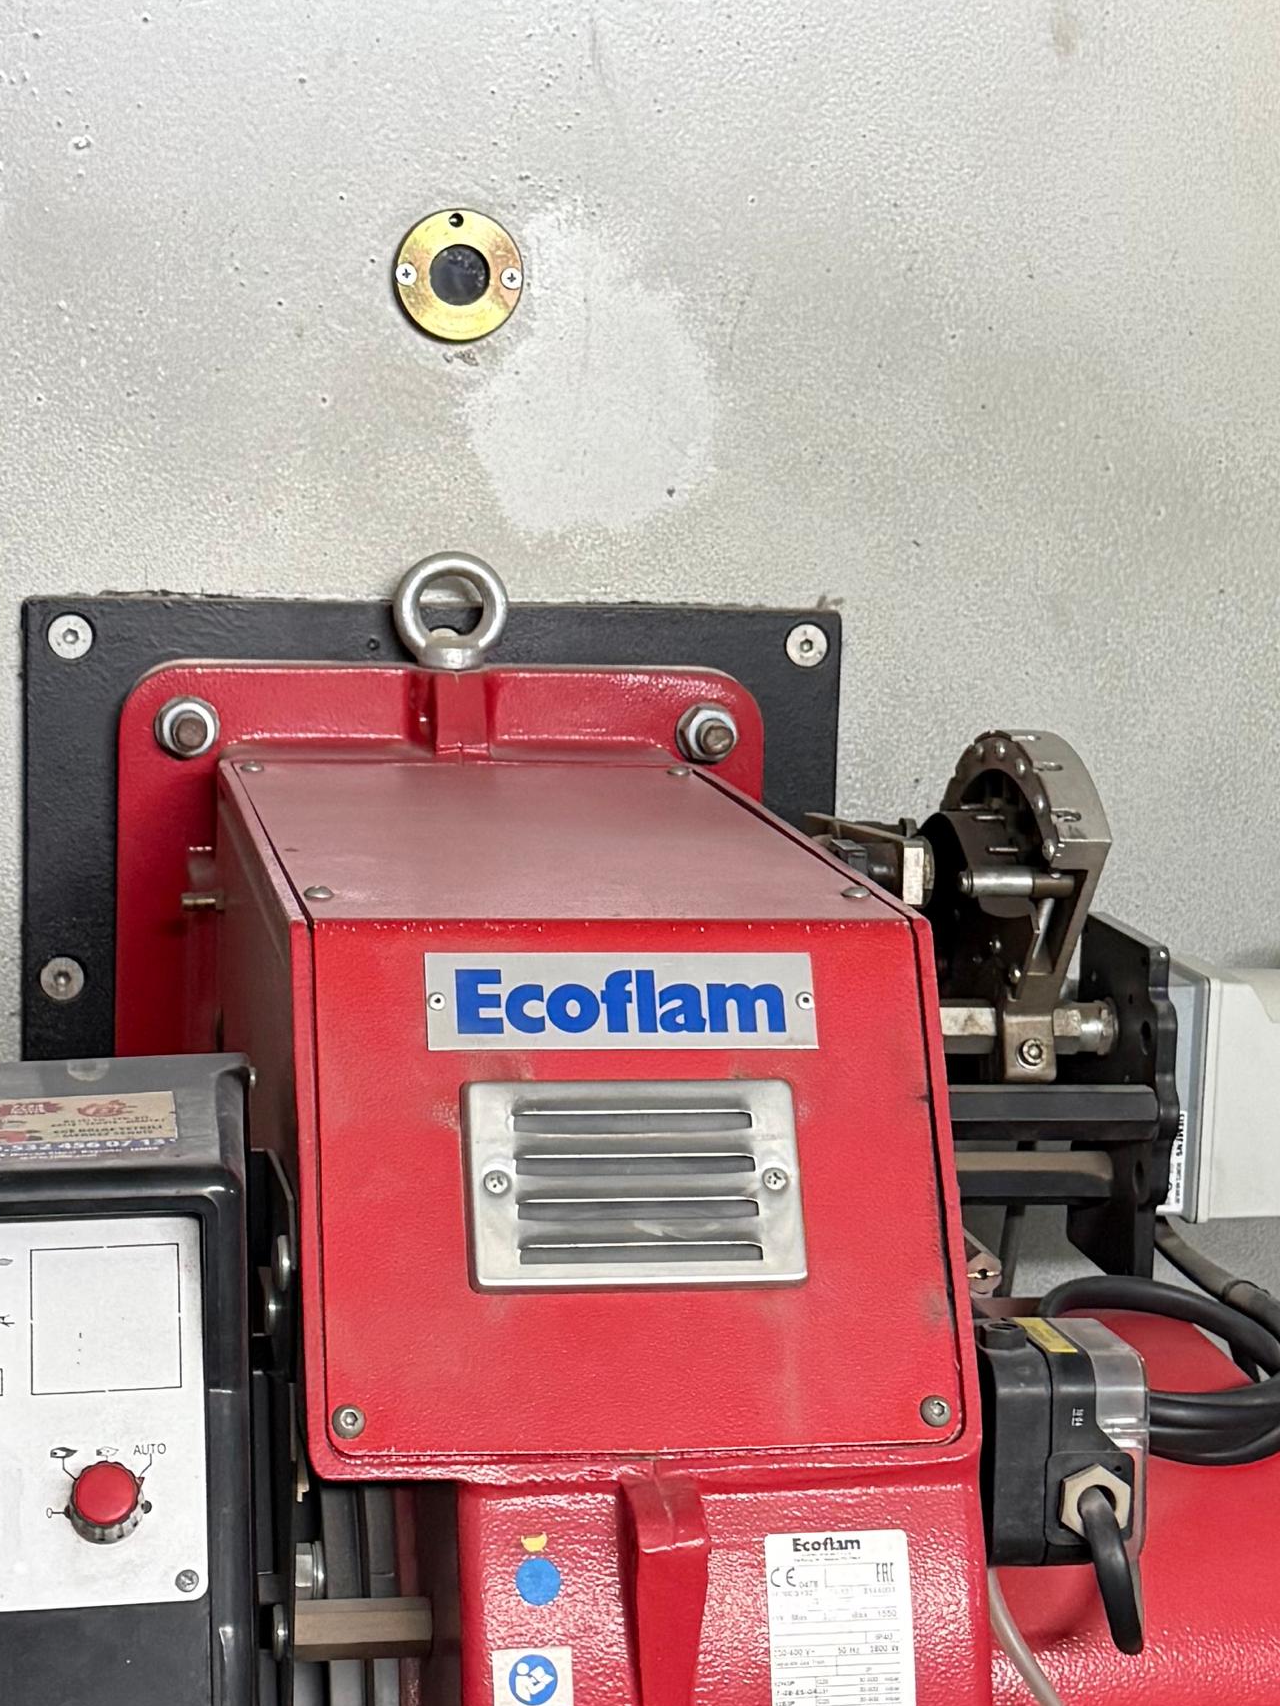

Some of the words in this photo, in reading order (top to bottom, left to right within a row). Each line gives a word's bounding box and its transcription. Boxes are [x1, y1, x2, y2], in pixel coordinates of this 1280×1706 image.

[454, 969, 788, 1035] Ecoflam
[133, 1443, 167, 1456] AUTO
[792, 1537, 861, 1552] Ecoflam
[771, 1567, 797, 1587] CE
